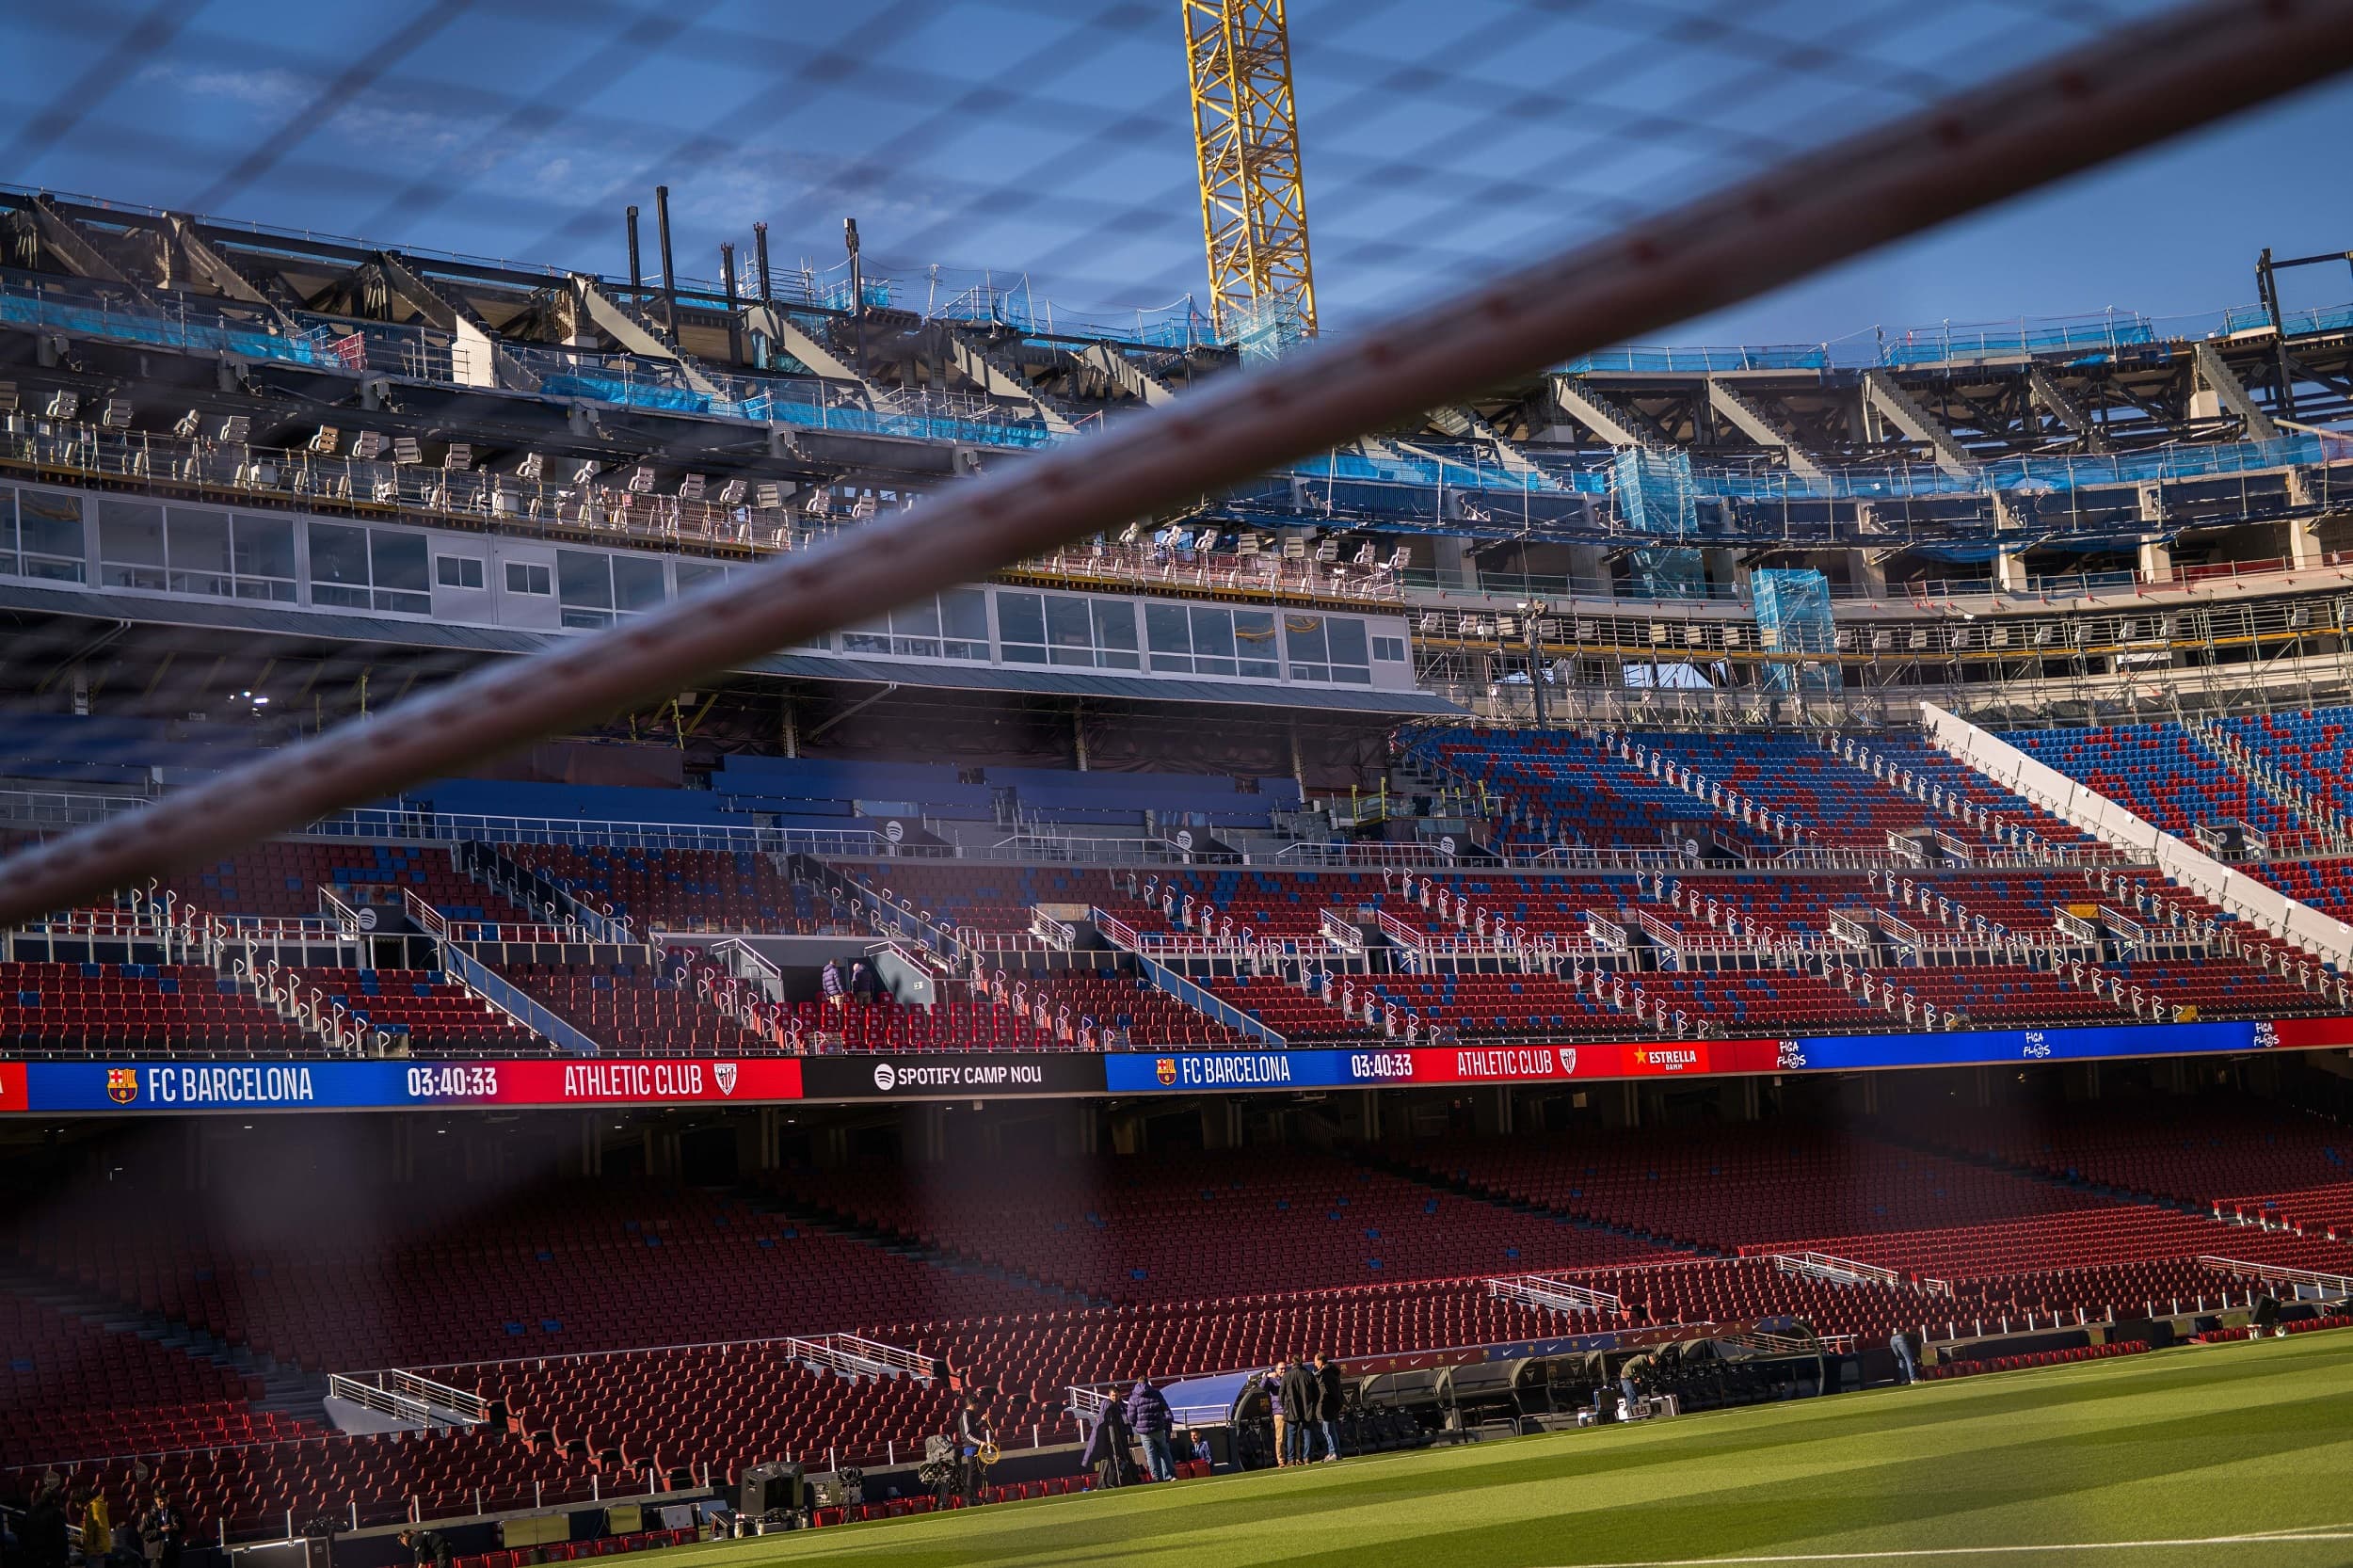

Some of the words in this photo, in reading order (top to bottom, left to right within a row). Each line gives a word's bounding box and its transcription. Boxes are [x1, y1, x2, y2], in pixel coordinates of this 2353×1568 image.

[1779, 1041, 1799, 1053] FIGA
[2025, 1032, 2044, 1044] FIGA
[1182, 1057, 1202, 1084] FC
[1205, 1055, 1291, 1083] BARCELONA
[1352, 1053, 1413, 1078] 03:40:33
[1457, 1050, 1516, 1077] ATHLETIC
[1519, 1049, 1552, 1075] CLUB
[1648, 1050, 1697, 1064] ESTRELLA
[149, 1068, 176, 1102] FC
[182, 1067, 313, 1101] BARCELONA
[407, 1067, 498, 1096] 03:40:33
[564, 1065, 649, 1097] ATHLETIC
[654, 1064, 703, 1096] CLUB
[897, 1067, 961, 1085] SPOTIFY
[965, 1065, 1007, 1085] CAMP
[1011, 1065, 1042, 1083] NOU
